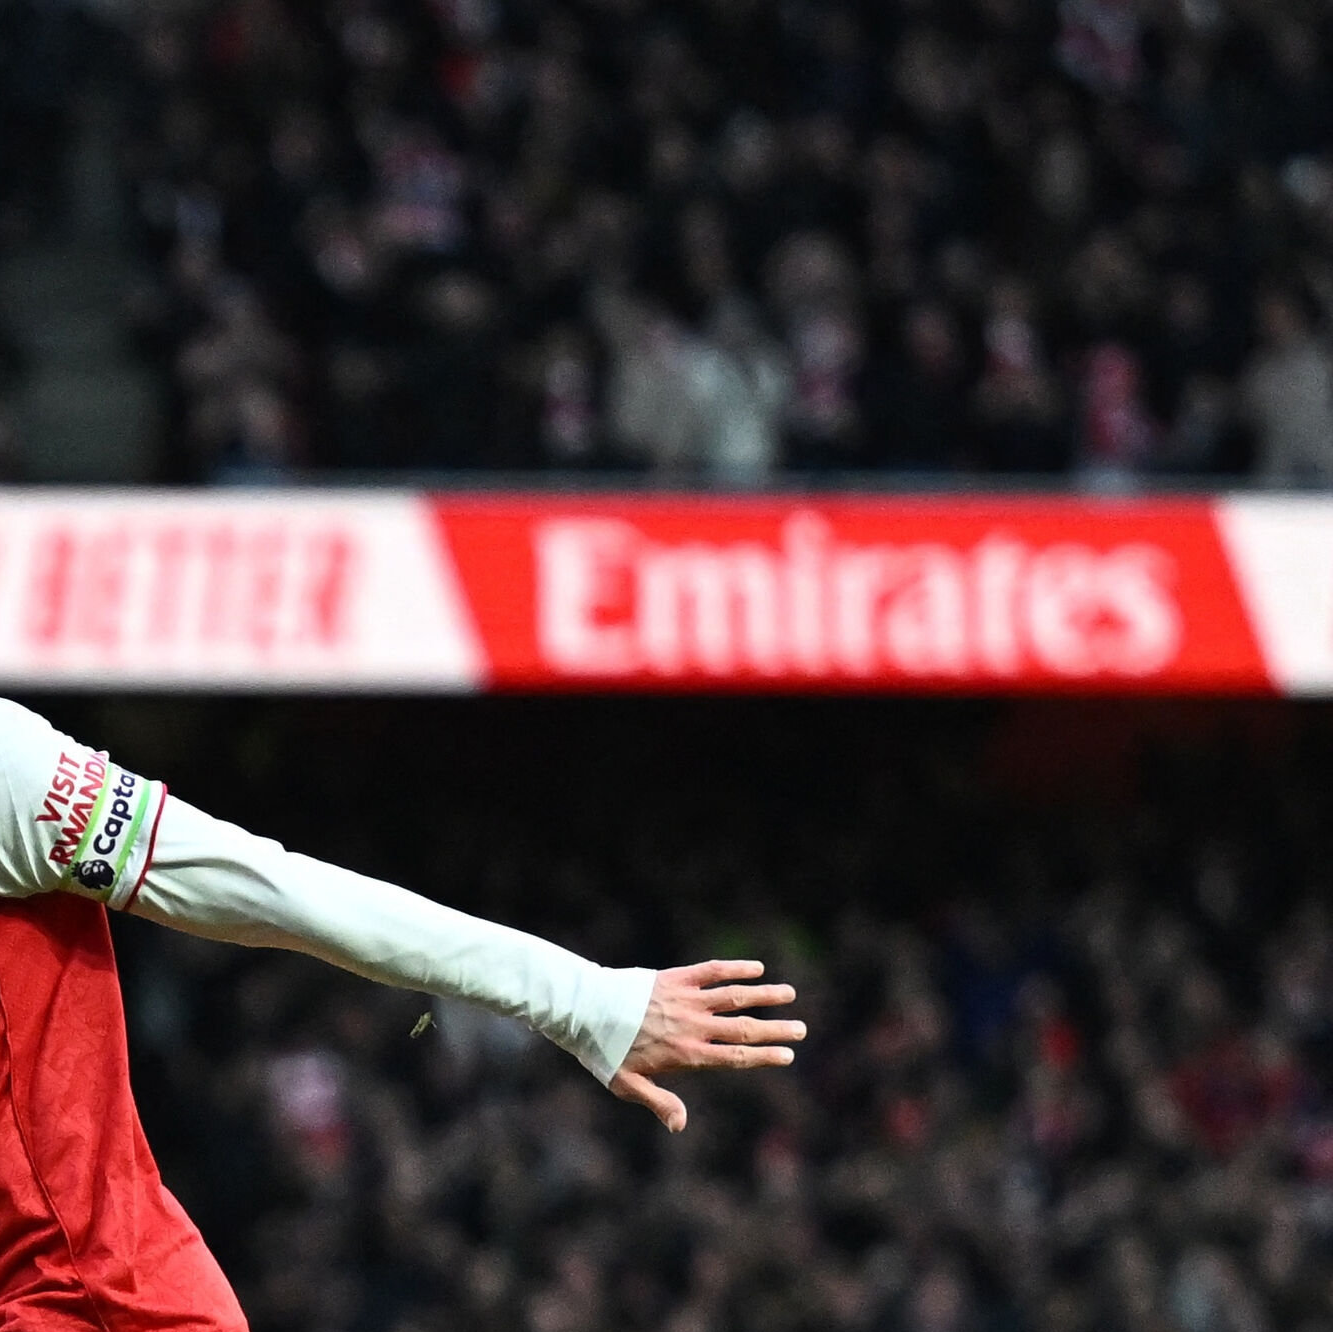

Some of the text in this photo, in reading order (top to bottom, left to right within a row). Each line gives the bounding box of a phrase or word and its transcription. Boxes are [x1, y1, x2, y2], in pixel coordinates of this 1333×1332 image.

[532, 508, 1185, 679] Emirates
[35, 751, 81, 823] VISIT
[93, 769, 136, 855] Capta
